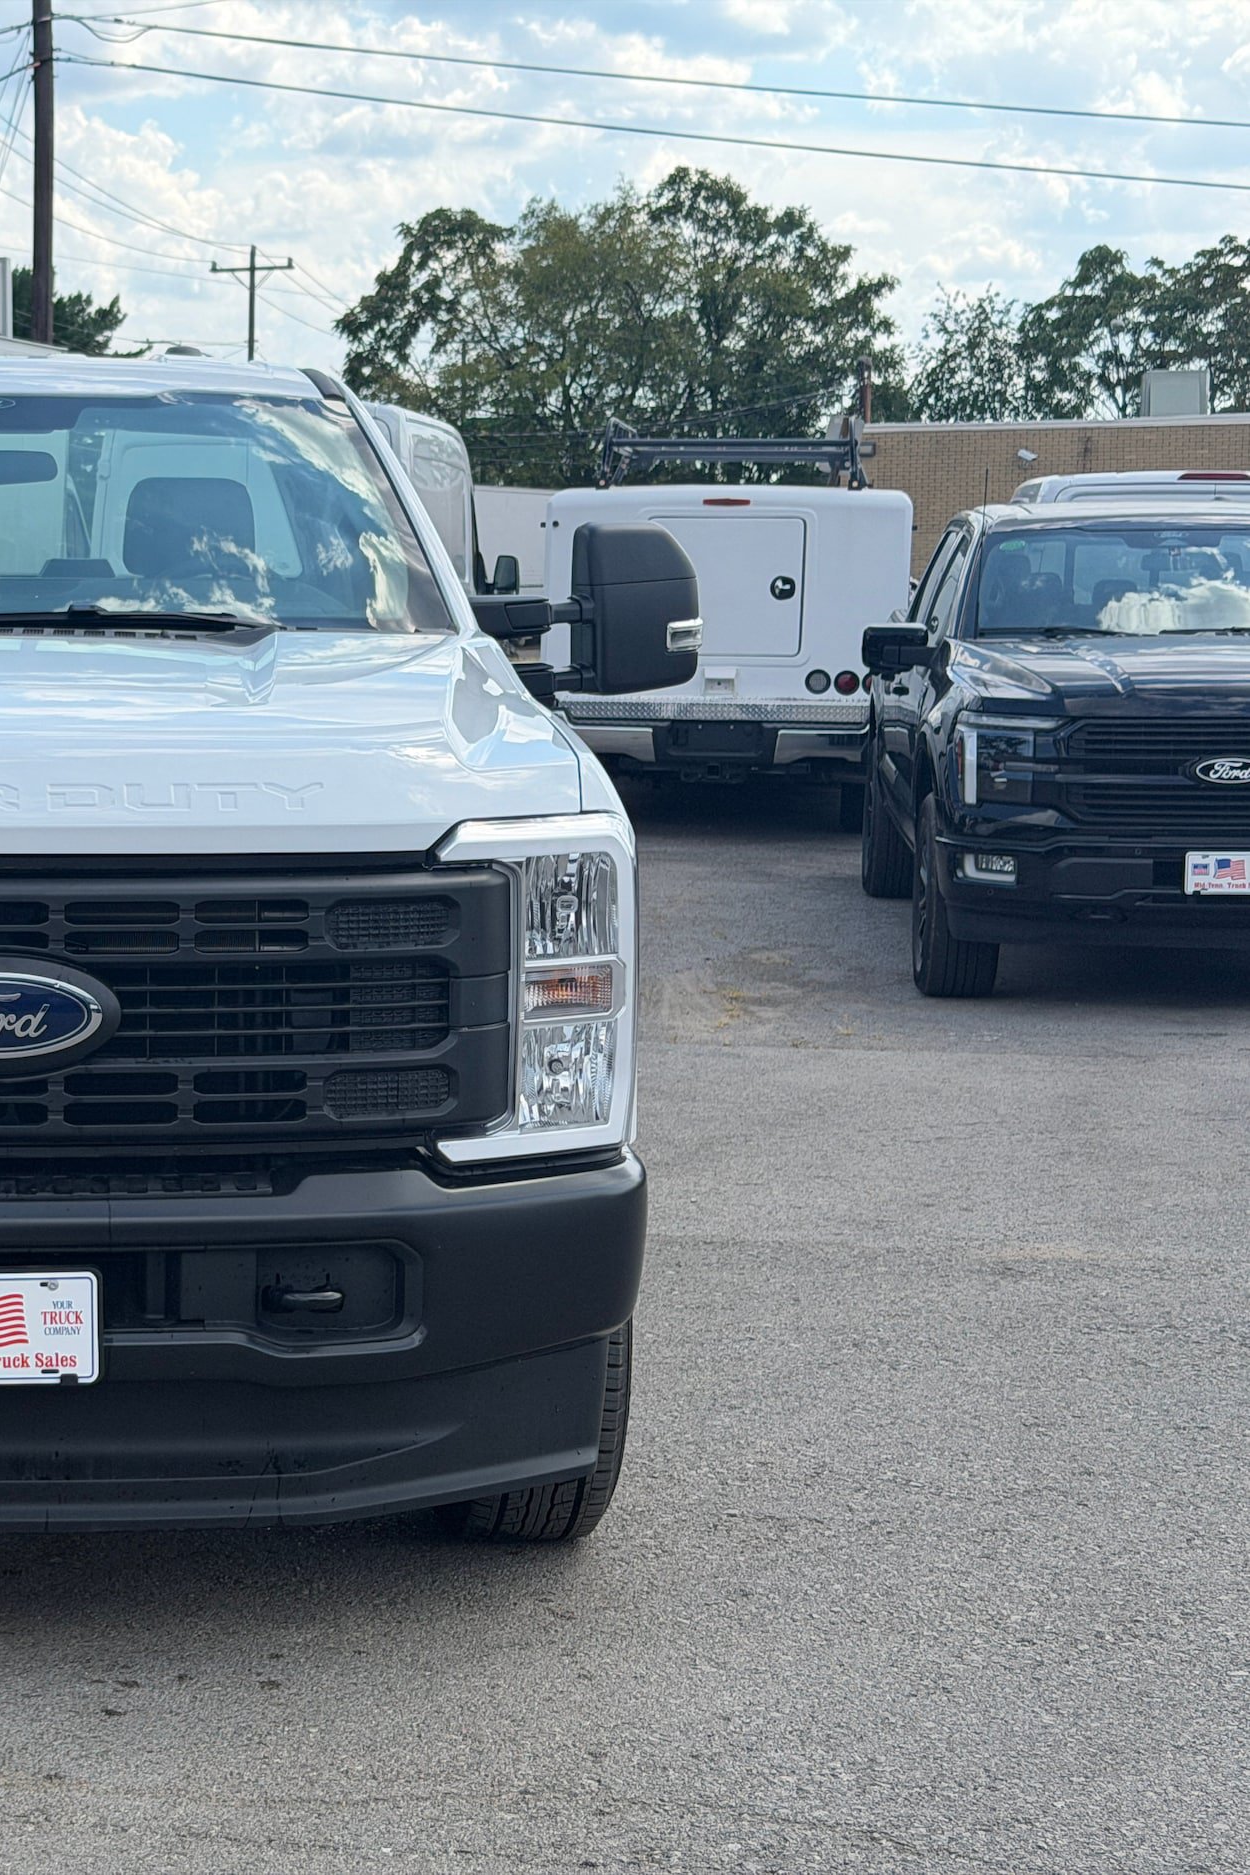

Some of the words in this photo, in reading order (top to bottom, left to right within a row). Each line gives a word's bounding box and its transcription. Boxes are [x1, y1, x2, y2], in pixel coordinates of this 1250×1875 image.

[1209, 761, 1250, 779] Ford
[45, 781, 325, 812] DUTY
[52, 1300, 73, 1310] YOUR
[41, 1310, 84, 1326] TRUCK
[44, 1326, 81, 1336] COMPANY
[35, 1352, 77, 1368] Sales
